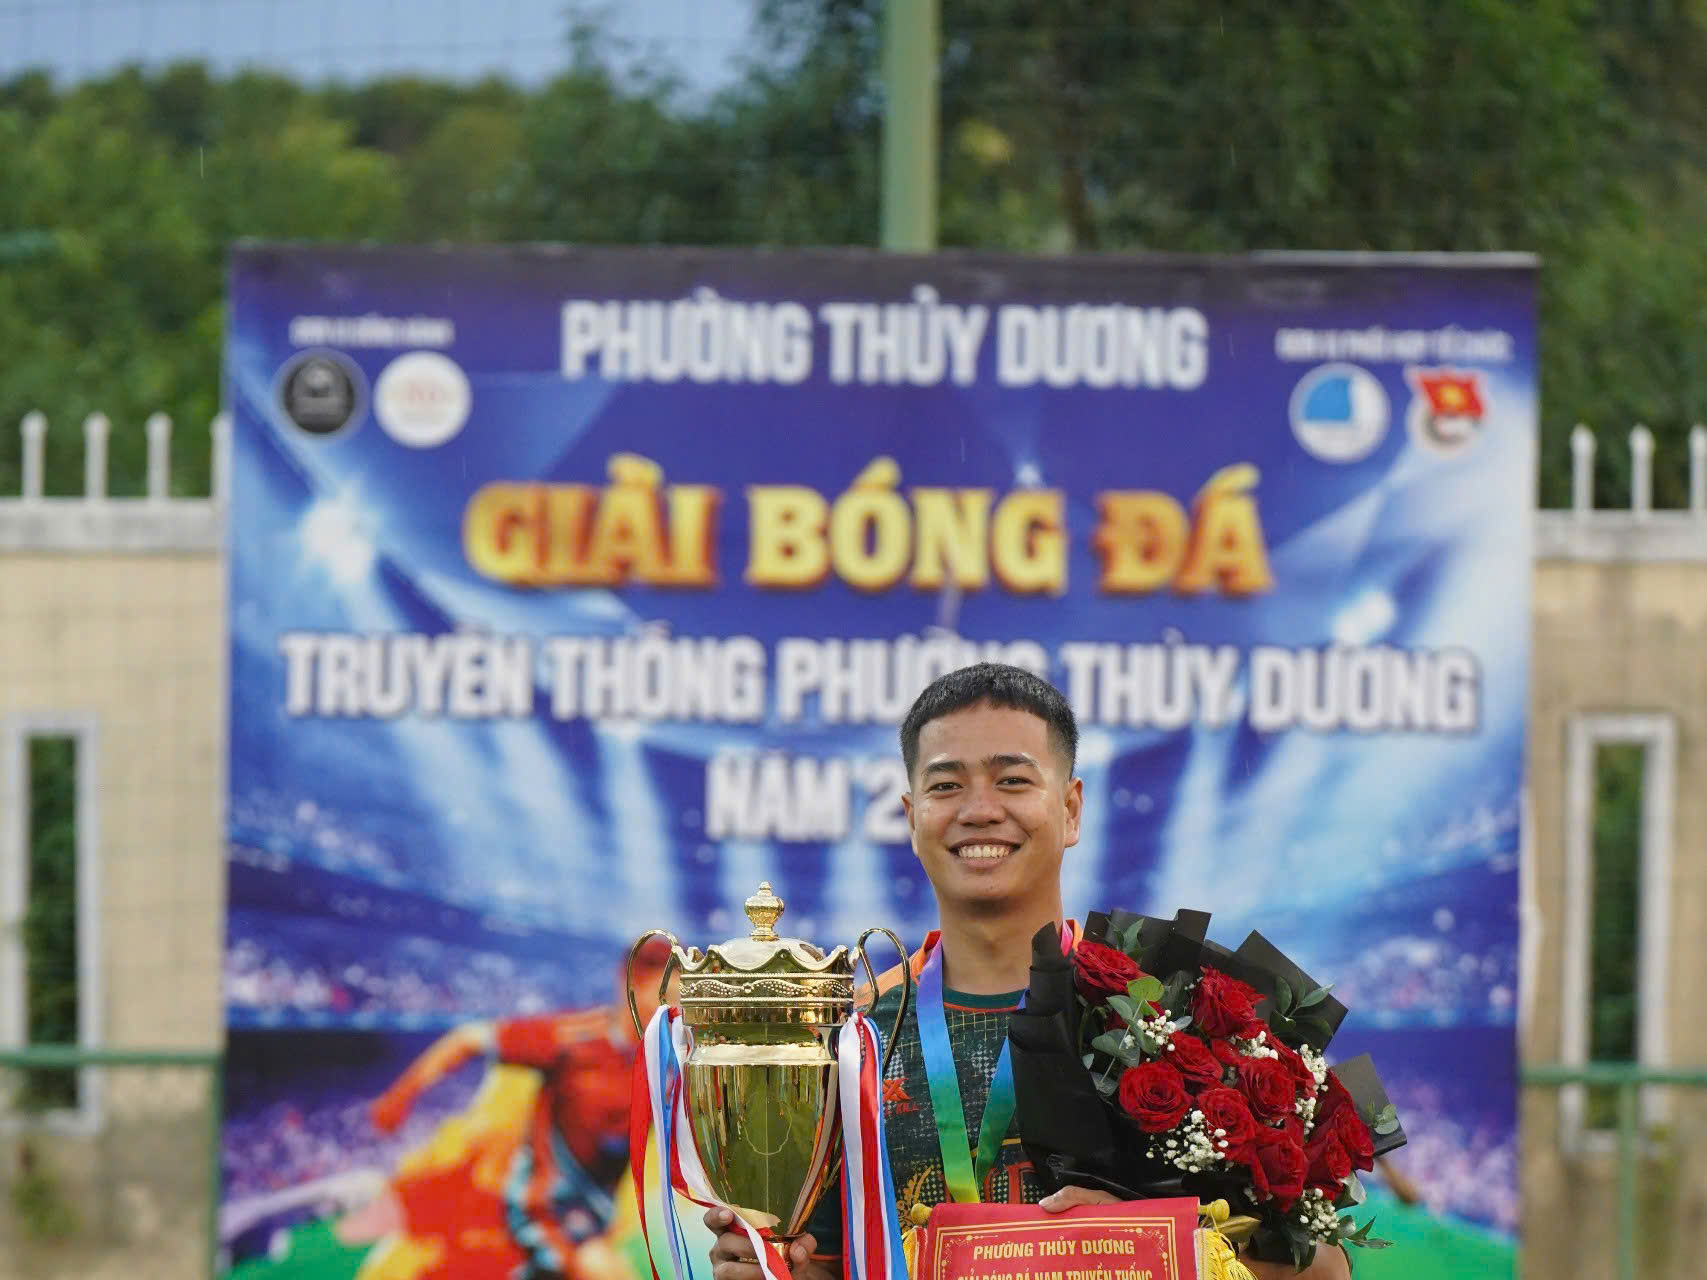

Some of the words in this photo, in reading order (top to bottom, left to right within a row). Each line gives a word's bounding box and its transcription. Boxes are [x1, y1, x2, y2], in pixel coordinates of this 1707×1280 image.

[822, 284, 988, 387] THỦY
[744, 456, 1068, 595] BÓNG
[1094, 463, 1274, 595] ĐÁ
[280, 621, 533, 719] TRUYỀN
[545, 621, 767, 721] THỐNG
[1061, 627, 1242, 729] THỦY
[973, 1241, 1034, 1260] PHƯỜNG
[1038, 1236, 1077, 1256] THỦY
[1081, 1239, 1135, 1255] DƯƠNG
